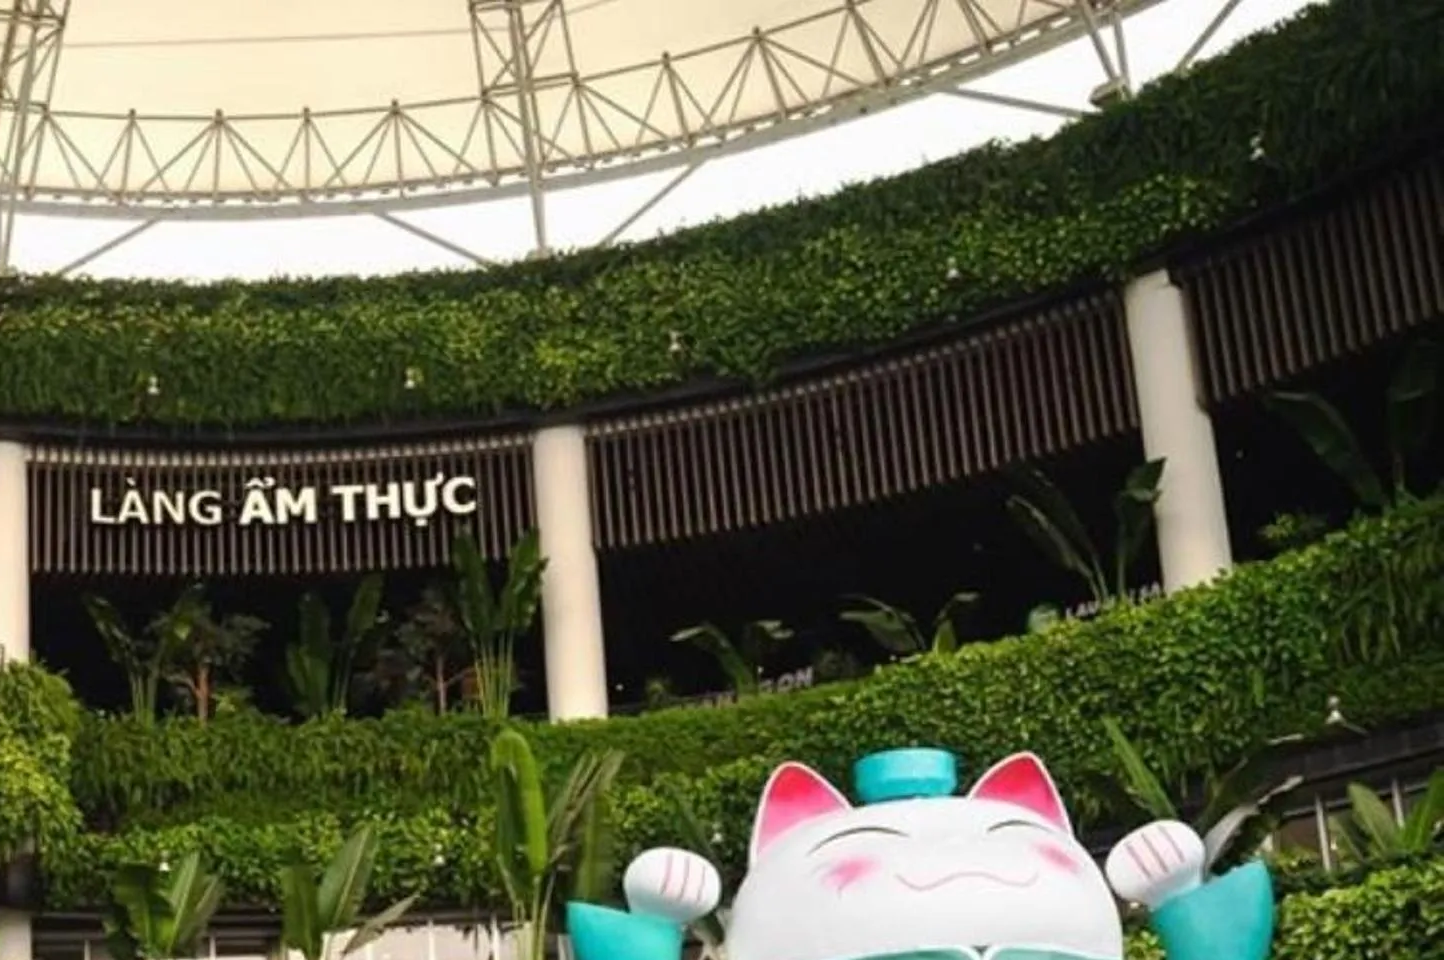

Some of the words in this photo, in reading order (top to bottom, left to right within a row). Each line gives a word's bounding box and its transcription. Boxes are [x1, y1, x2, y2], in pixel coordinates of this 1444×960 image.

[90, 476, 222, 525] LÀNG
[239, 476, 318, 525] ẨM
[331, 472, 477, 527] THỰC
